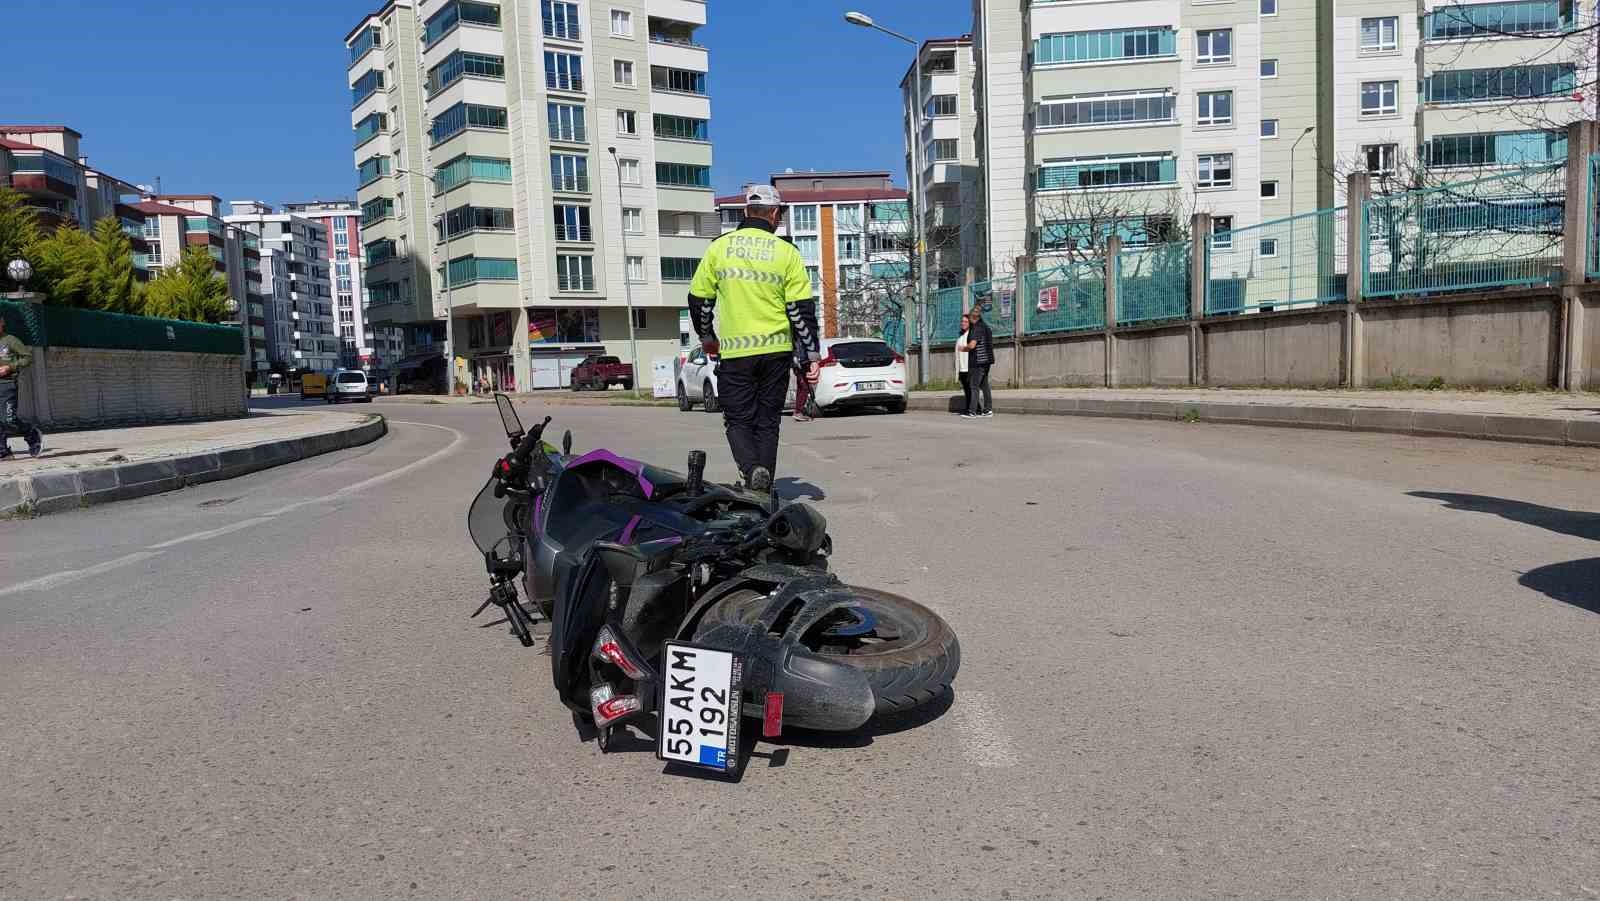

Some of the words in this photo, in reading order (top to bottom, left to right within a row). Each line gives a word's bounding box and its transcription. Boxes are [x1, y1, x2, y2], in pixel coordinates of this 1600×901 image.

[670, 650, 697, 713] AKM
[699, 686, 726, 737] 192
[667, 718, 693, 756] 55
[717, 751, 727, 763] TR
